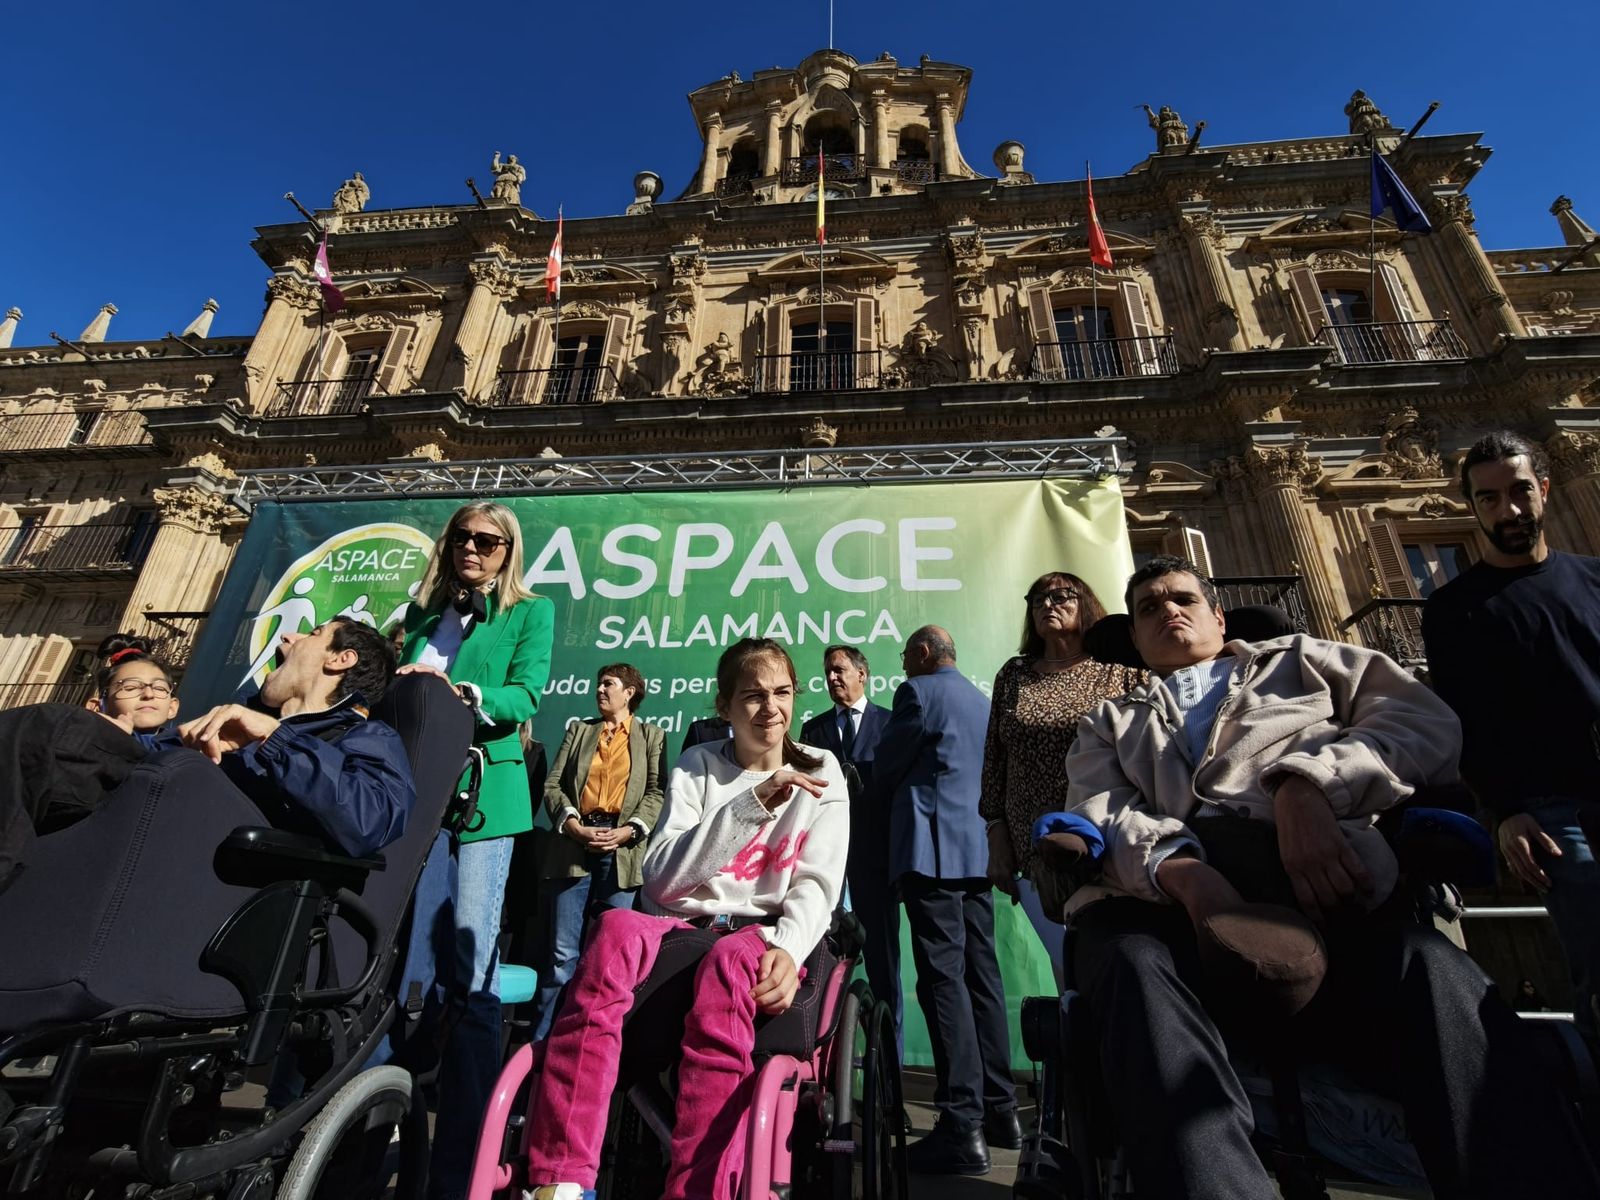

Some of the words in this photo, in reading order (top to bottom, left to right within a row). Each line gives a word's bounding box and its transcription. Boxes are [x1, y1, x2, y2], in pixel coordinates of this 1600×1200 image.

[313, 548, 422, 572] ASPACE
[521, 516, 962, 600] ASPACE
[331, 573, 400, 583] SALAMANCA
[595, 608, 903, 650] SALAMANCA
